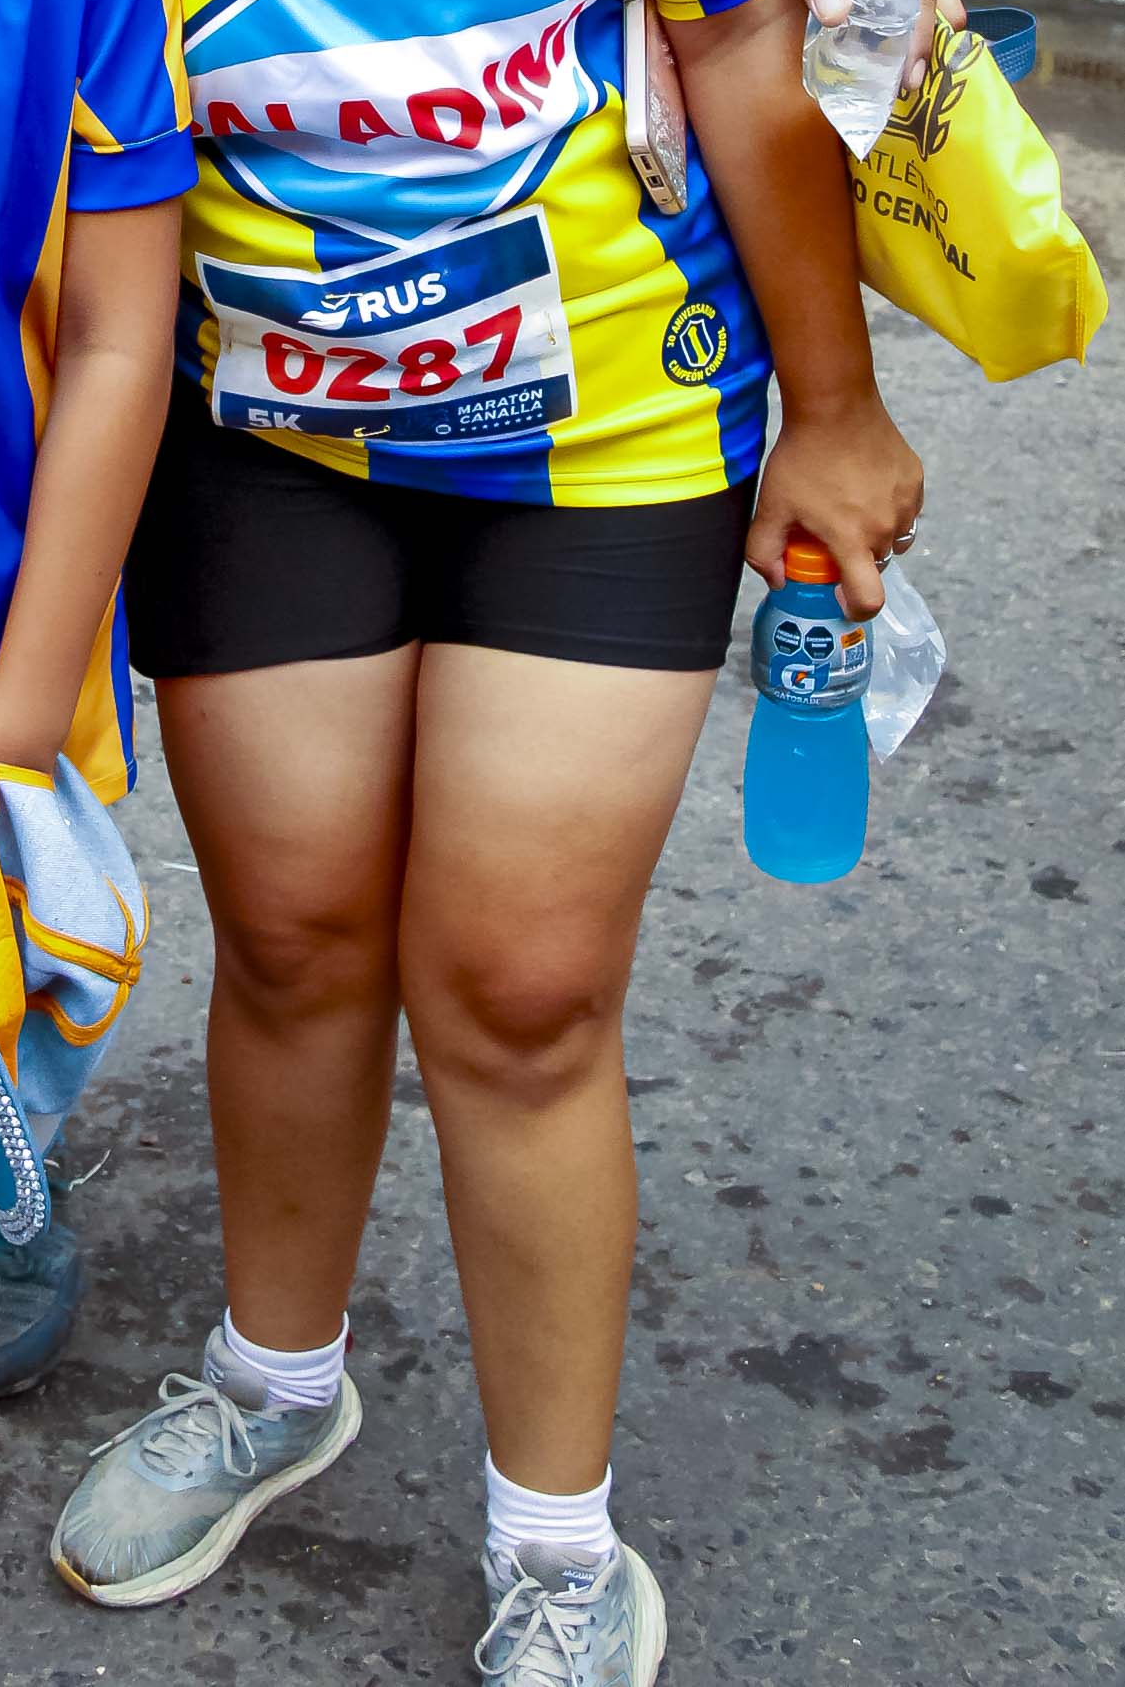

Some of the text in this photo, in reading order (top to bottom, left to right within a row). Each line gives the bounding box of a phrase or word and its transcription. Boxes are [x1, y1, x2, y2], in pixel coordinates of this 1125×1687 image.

[356, 271, 448, 324] RUS
[260, 304, 523, 402] 0287
[457, 388, 543, 416] MARATÓN
[459, 400, 543, 425] CANALLA
[247, 407, 301, 431] 5K
[781, 663, 816, 695] G
